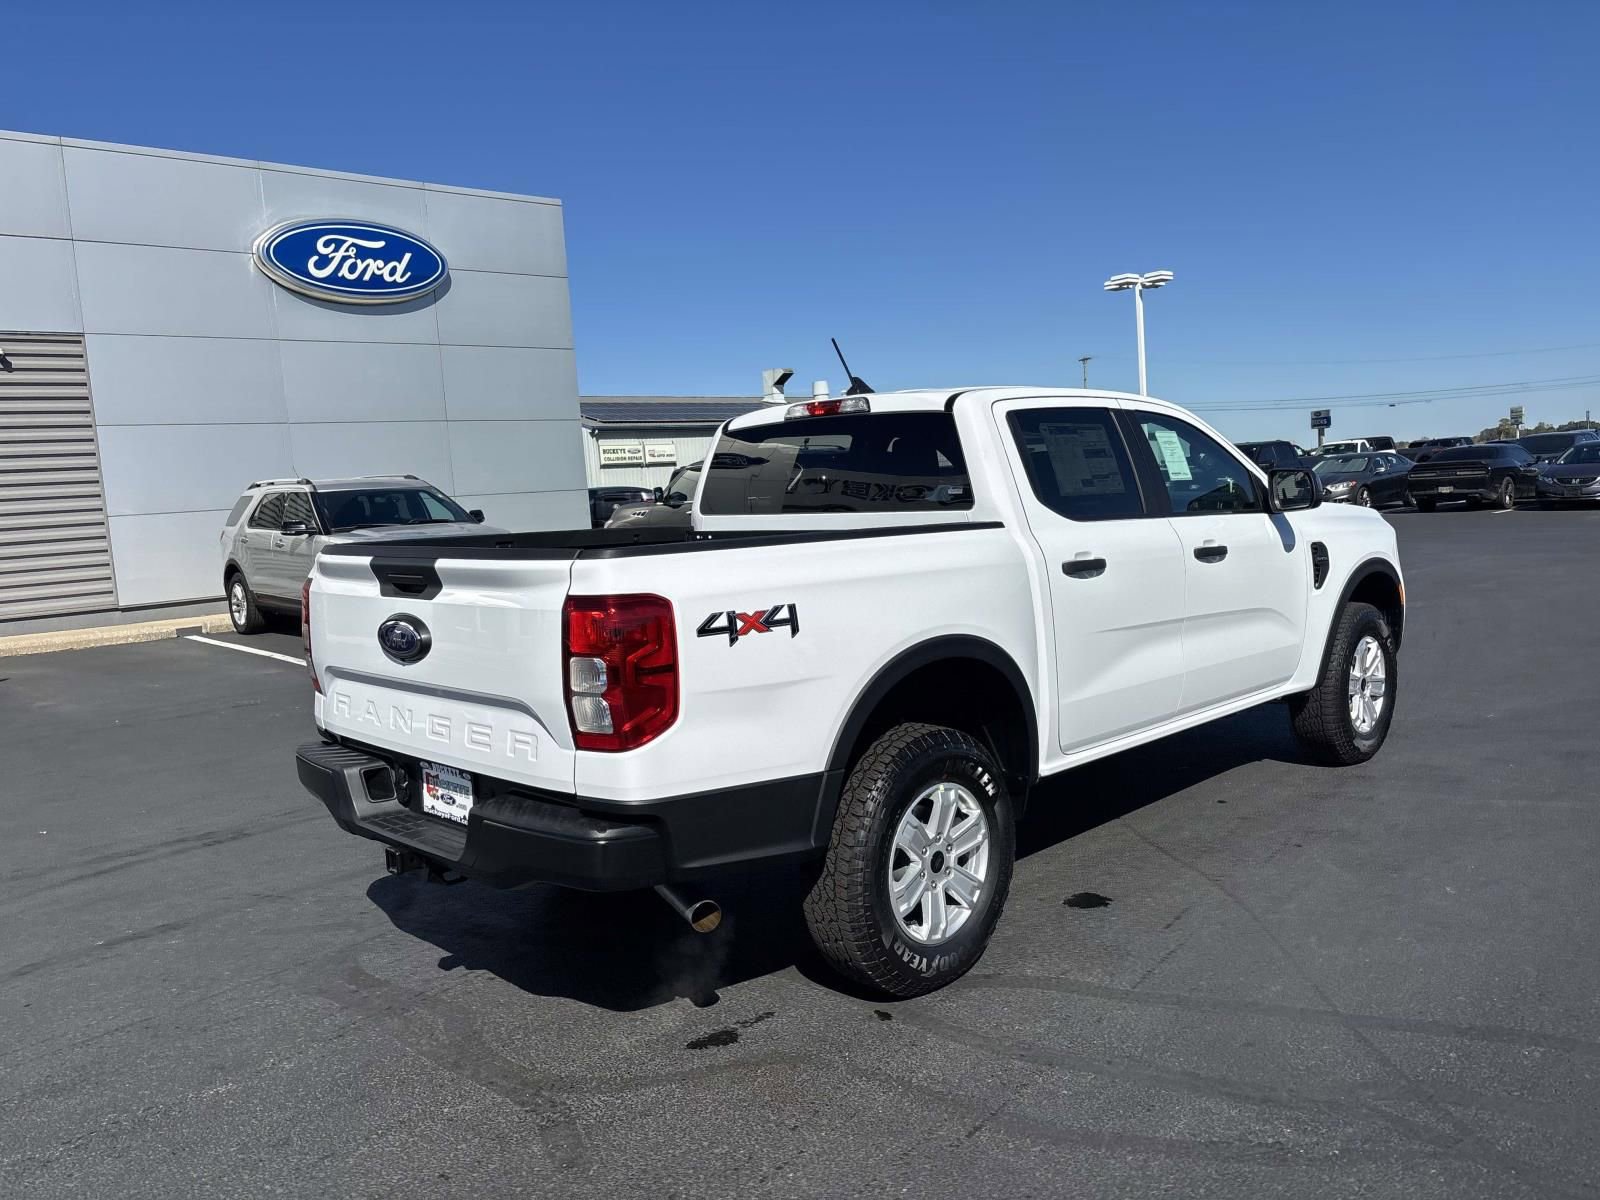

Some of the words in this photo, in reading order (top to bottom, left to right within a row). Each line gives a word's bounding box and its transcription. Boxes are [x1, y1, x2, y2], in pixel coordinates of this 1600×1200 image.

[308, 235, 412, 283] Ford
[333, 691, 539, 762] RANGER
[893, 940, 962, 977] ODYEAR
